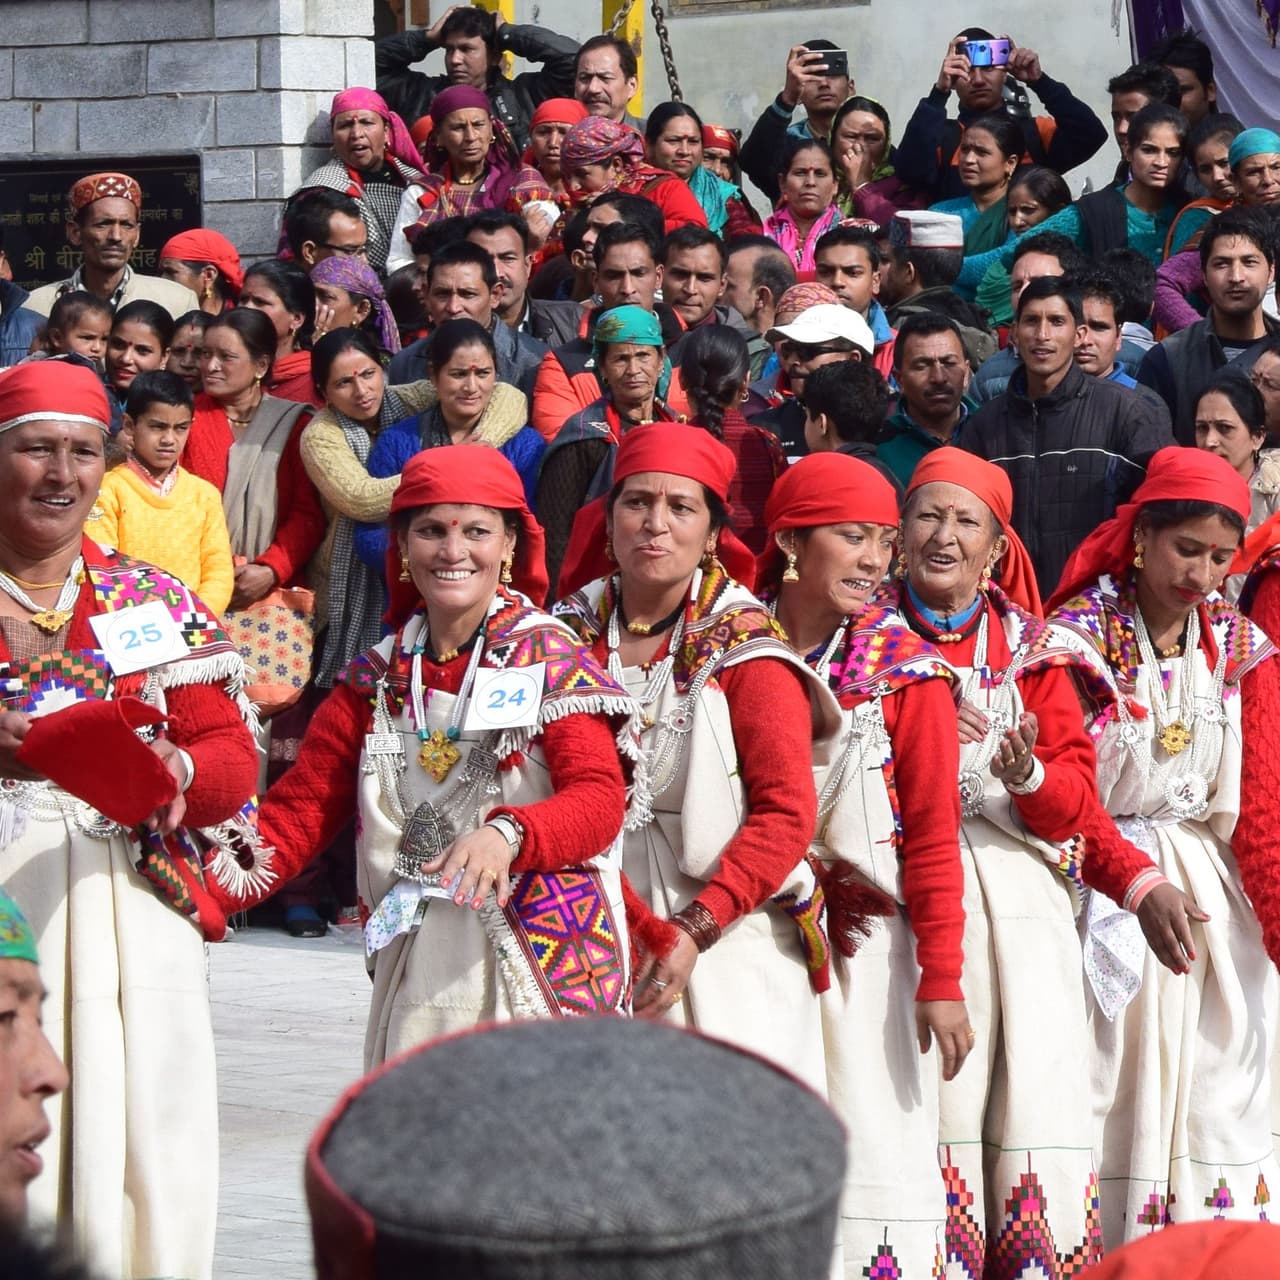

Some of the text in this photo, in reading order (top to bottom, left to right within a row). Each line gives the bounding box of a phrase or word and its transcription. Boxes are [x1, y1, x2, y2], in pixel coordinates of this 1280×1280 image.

[24, 246, 46, 270] श्री
[119, 622, 163, 651] 25
[487, 687, 526, 710] 24
